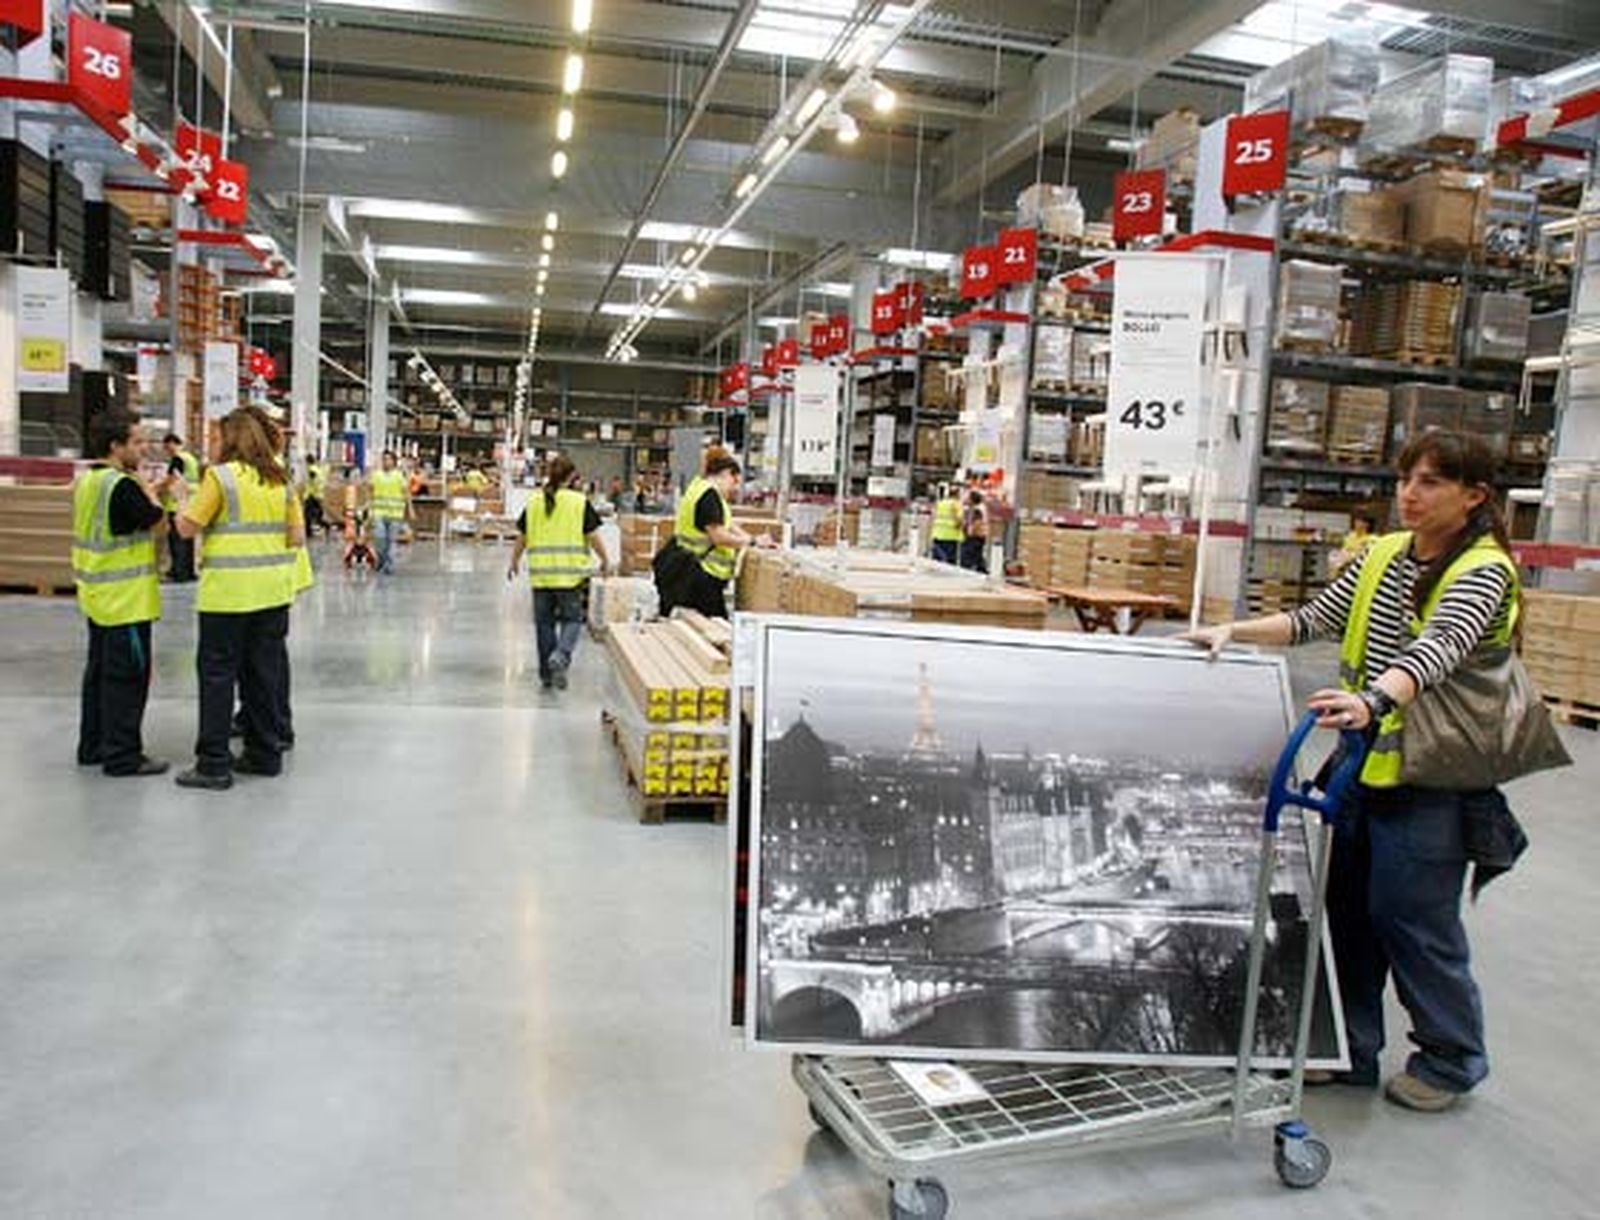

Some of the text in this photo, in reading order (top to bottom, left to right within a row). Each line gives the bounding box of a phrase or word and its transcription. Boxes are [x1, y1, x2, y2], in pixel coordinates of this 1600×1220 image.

[83, 47, 121, 79] 26
[186, 150, 212, 173] 24
[1233, 139, 1273, 165] 25
[217, 179, 241, 201] 22
[1122, 192, 1152, 213] 23
[1004, 247, 1026, 263] 21
[968, 262, 989, 279] 19
